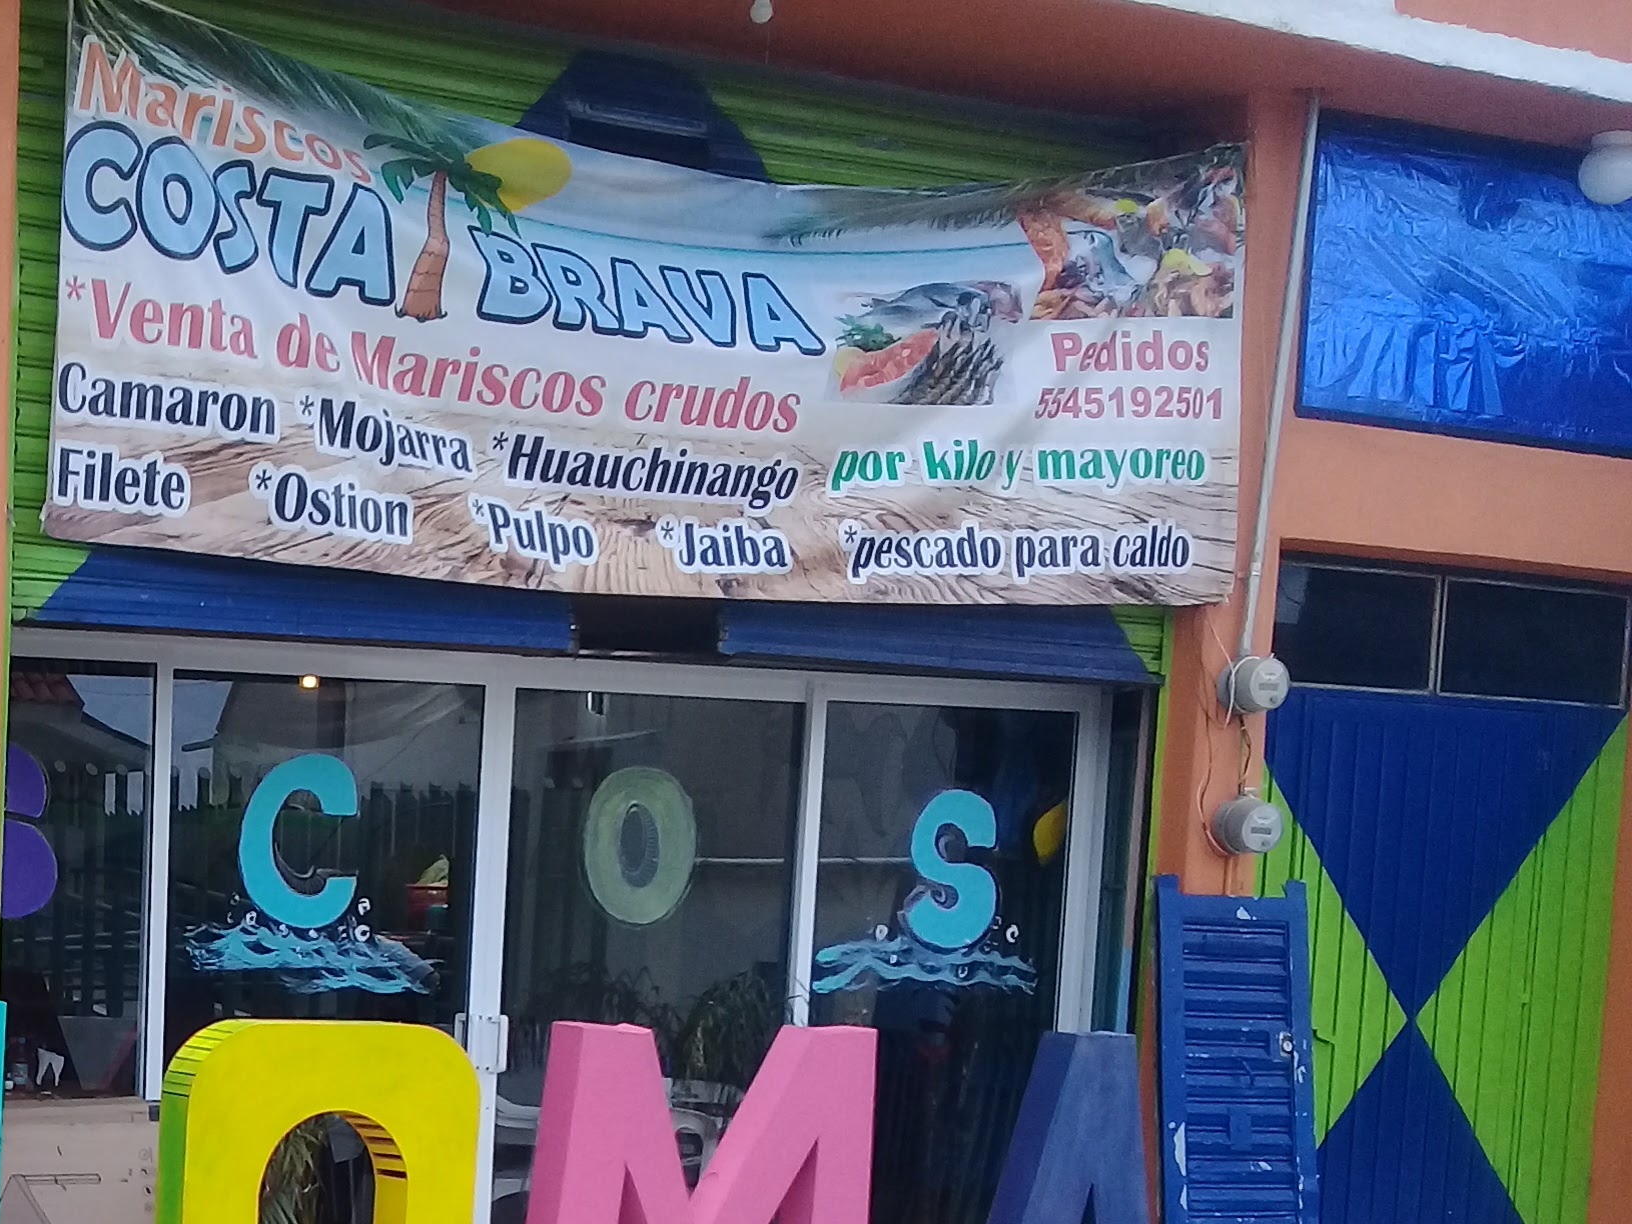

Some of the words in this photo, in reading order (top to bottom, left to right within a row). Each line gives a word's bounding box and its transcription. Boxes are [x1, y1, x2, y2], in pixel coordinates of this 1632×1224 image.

[76, 41, 373, 184] Mariscos
[63, 121, 397, 306] COSTA
[470, 225, 826, 357] BRAVA
[91, 278, 258, 361] Venta
[276, 314, 341, 375] de
[351, 331, 606, 418] Mariscos
[625, 376, 801, 434] crudos
[1034, 386, 1222, 420] 5545192501
[1050, 330, 1210, 372] Pedidos
[59, 361, 276, 437] Camaron
[316, 397, 472, 475] Mojarra
[506, 432, 799, 509] Huauchinango
[831, 447, 905, 490] por
[924, 440, 994, 481] kilo
[1001, 450, 1024, 490] y
[1037, 442, 1206, 489] mayoreo
[58, 447, 187, 510] Filete
[274, 471, 410, 540] Ostion
[491, 504, 596, 566] Pulpo
[678, 527, 789, 568] Jaiba
[851, 524, 1001, 580] pescado
[1014, 528, 1101, 577] para
[1113, 523, 1191, 571] caldo
